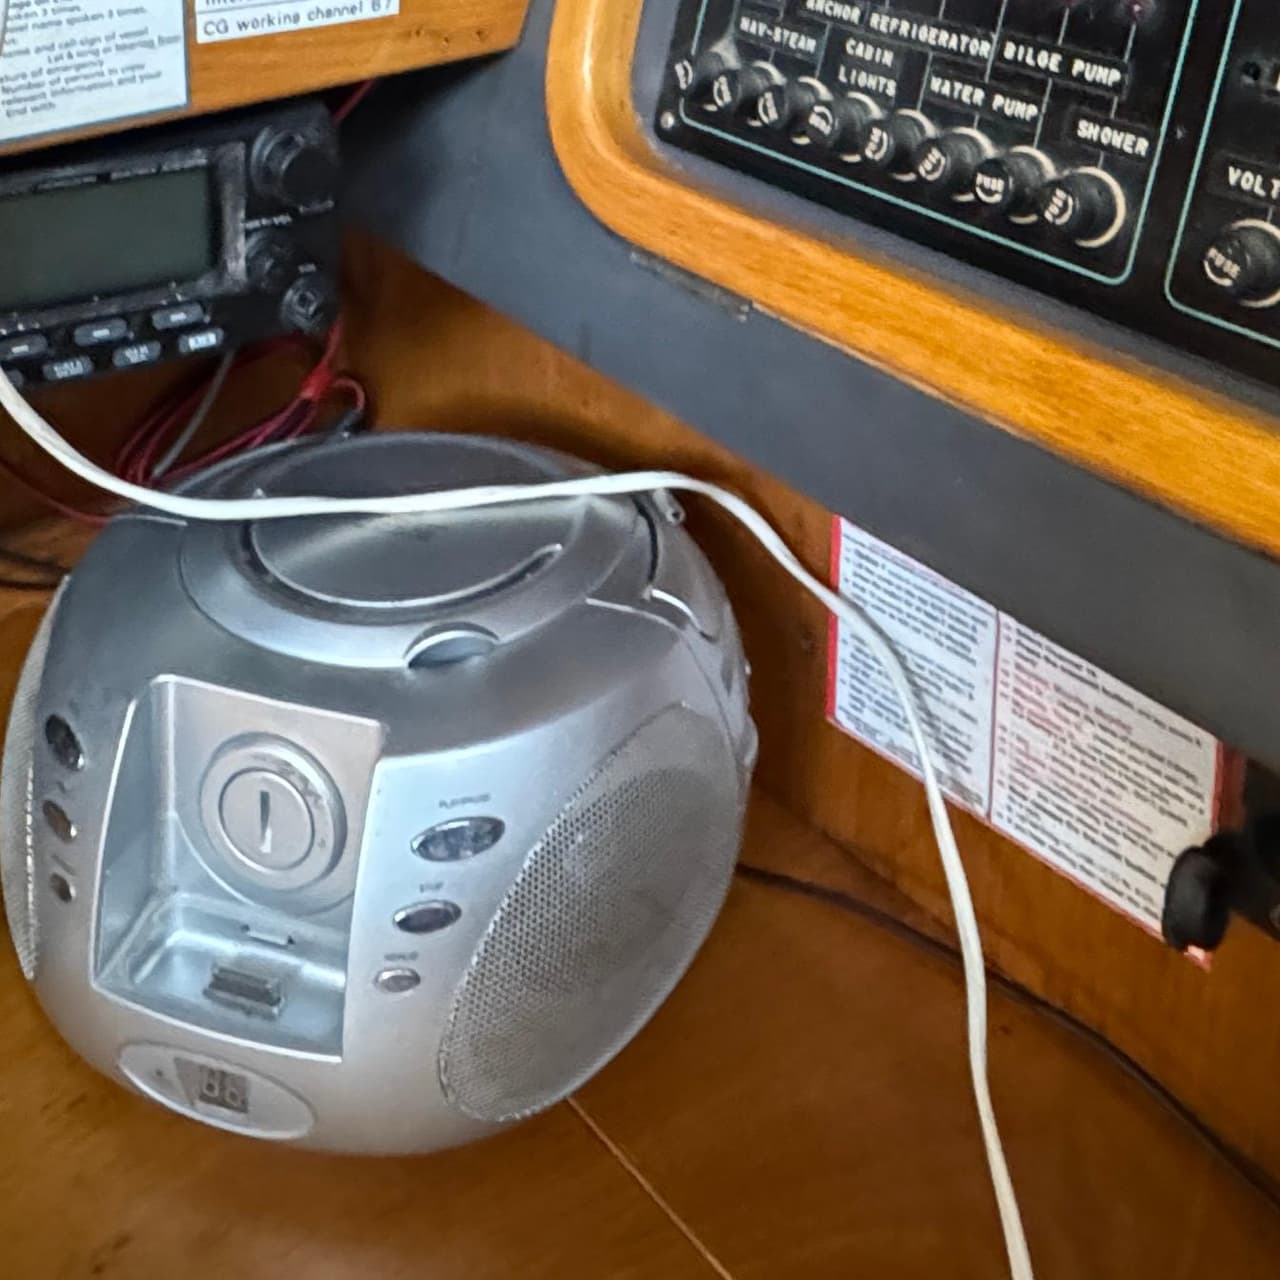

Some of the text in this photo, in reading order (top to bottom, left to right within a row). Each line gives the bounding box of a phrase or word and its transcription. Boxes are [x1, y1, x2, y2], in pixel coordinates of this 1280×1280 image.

[203, 20, 230, 37] CG
[236, 10, 302, 32] working
[306, 1, 365, 22] channel
[738, 16, 817, 55] NAV-STEAM
[869, 11, 993, 60] REFRIGERATOR
[845, 37, 895, 68] CABIN
[1003, 41, 1123, 89] BILGE PUMP
[837, 64, 898, 98] LIGHTS
[929, 75, 1039, 123] WATER PUMP
[1076, 119, 1150, 158] SHOWER
